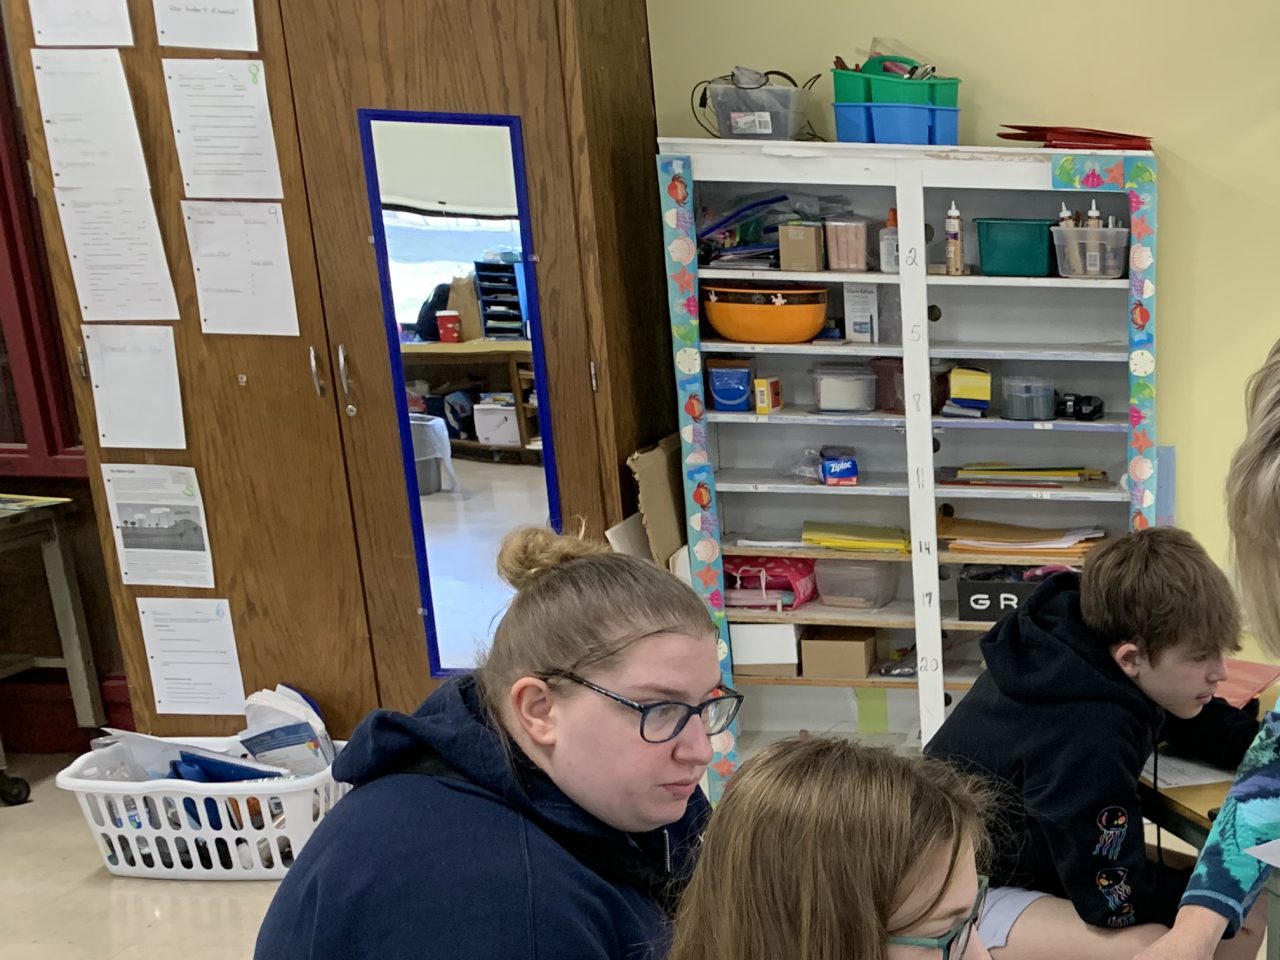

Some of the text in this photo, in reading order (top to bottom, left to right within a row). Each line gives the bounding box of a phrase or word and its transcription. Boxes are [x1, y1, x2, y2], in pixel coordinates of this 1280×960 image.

[906, 247, 918, 266] 2
[830, 461, 852, 474] Ziploc
[919, 540, 931, 555] 14
[919, 657, 939, 672] 20
